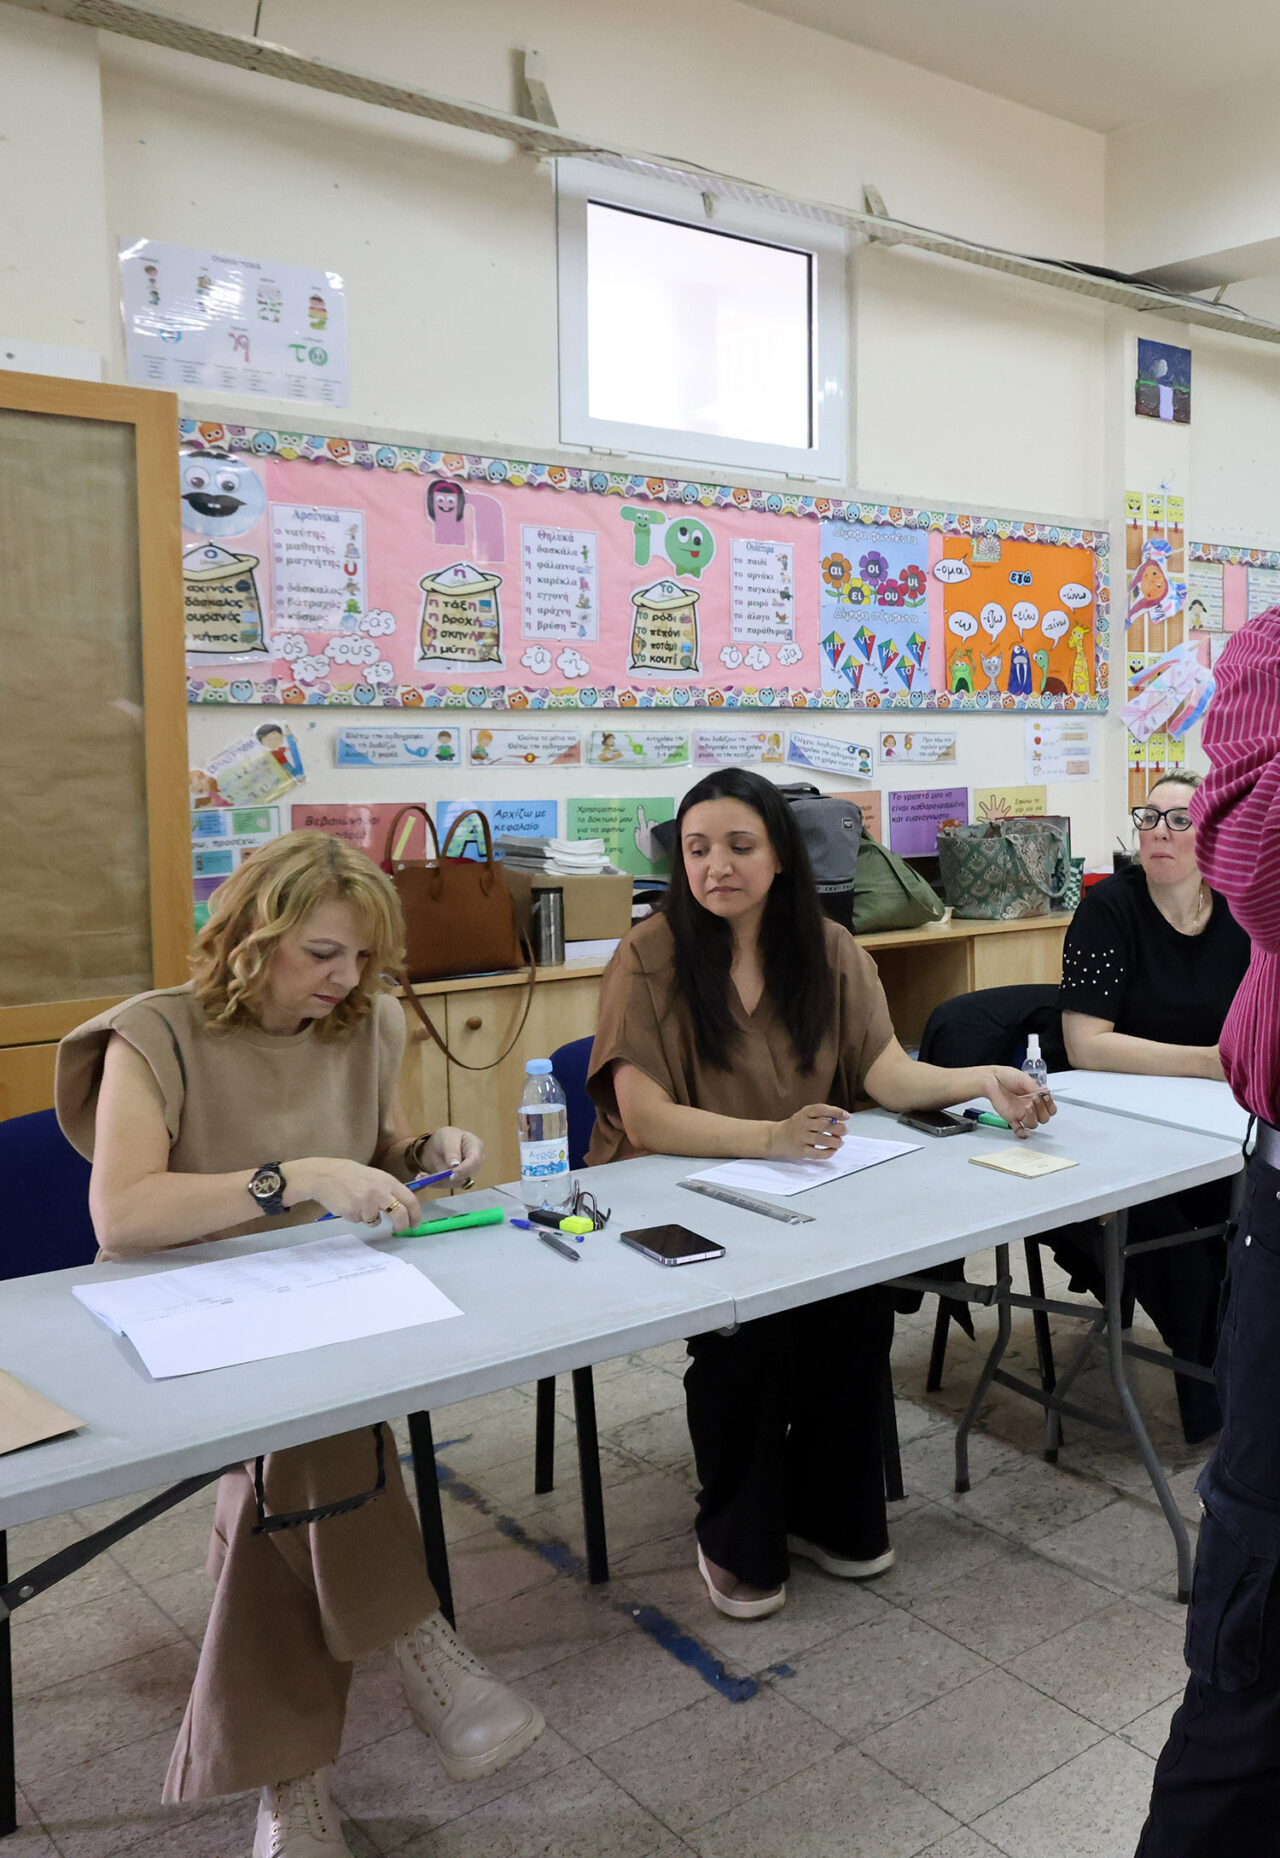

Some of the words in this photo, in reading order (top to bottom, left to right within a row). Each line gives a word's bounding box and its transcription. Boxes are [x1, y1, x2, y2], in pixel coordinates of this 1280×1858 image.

[536, 575, 578, 588] καρέκλα
[442, 600, 477, 612] τάξη
[495, 808, 532, 819] Αρχίζω
[535, 810, 546, 818] με
